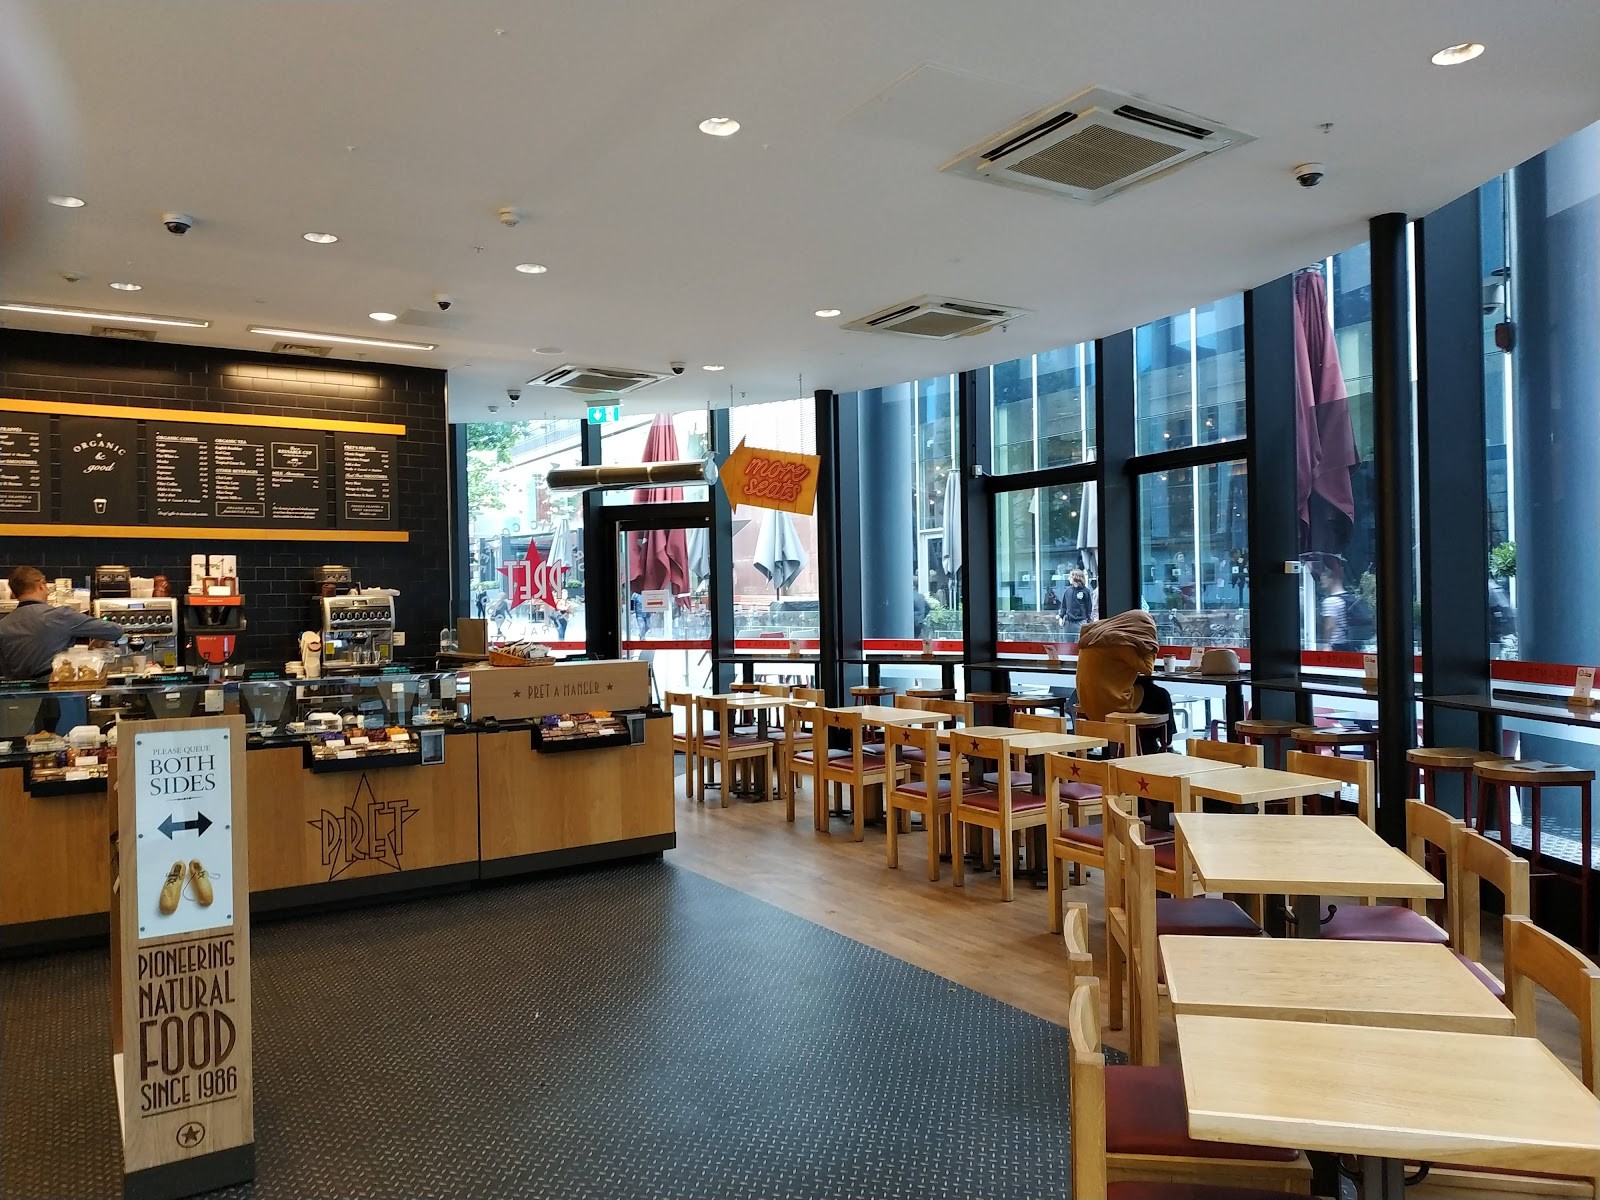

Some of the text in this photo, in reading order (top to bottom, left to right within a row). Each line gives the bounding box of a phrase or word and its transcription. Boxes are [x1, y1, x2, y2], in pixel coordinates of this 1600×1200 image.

[73, 440, 126, 456] ORGANIC
[94, 451, 107, 460] &
[83, 462, 116, 474] good
[745, 458, 810, 482] more
[743, 478, 801, 502] seats
[528, 681, 600, 700] PRET A MANGER
[153, 745, 211, 756] PLEASE QUEUE
[149, 754, 215, 775] BOTH
[150, 773, 216, 796] SIDES
[320, 799, 409, 866] PRET
[138, 940, 235, 981] PIONEERING
[138, 970, 236, 1019] NATURAL
[139, 1009, 237, 1081] FOOD
[140, 1065, 238, 1112] SINCE 1986
